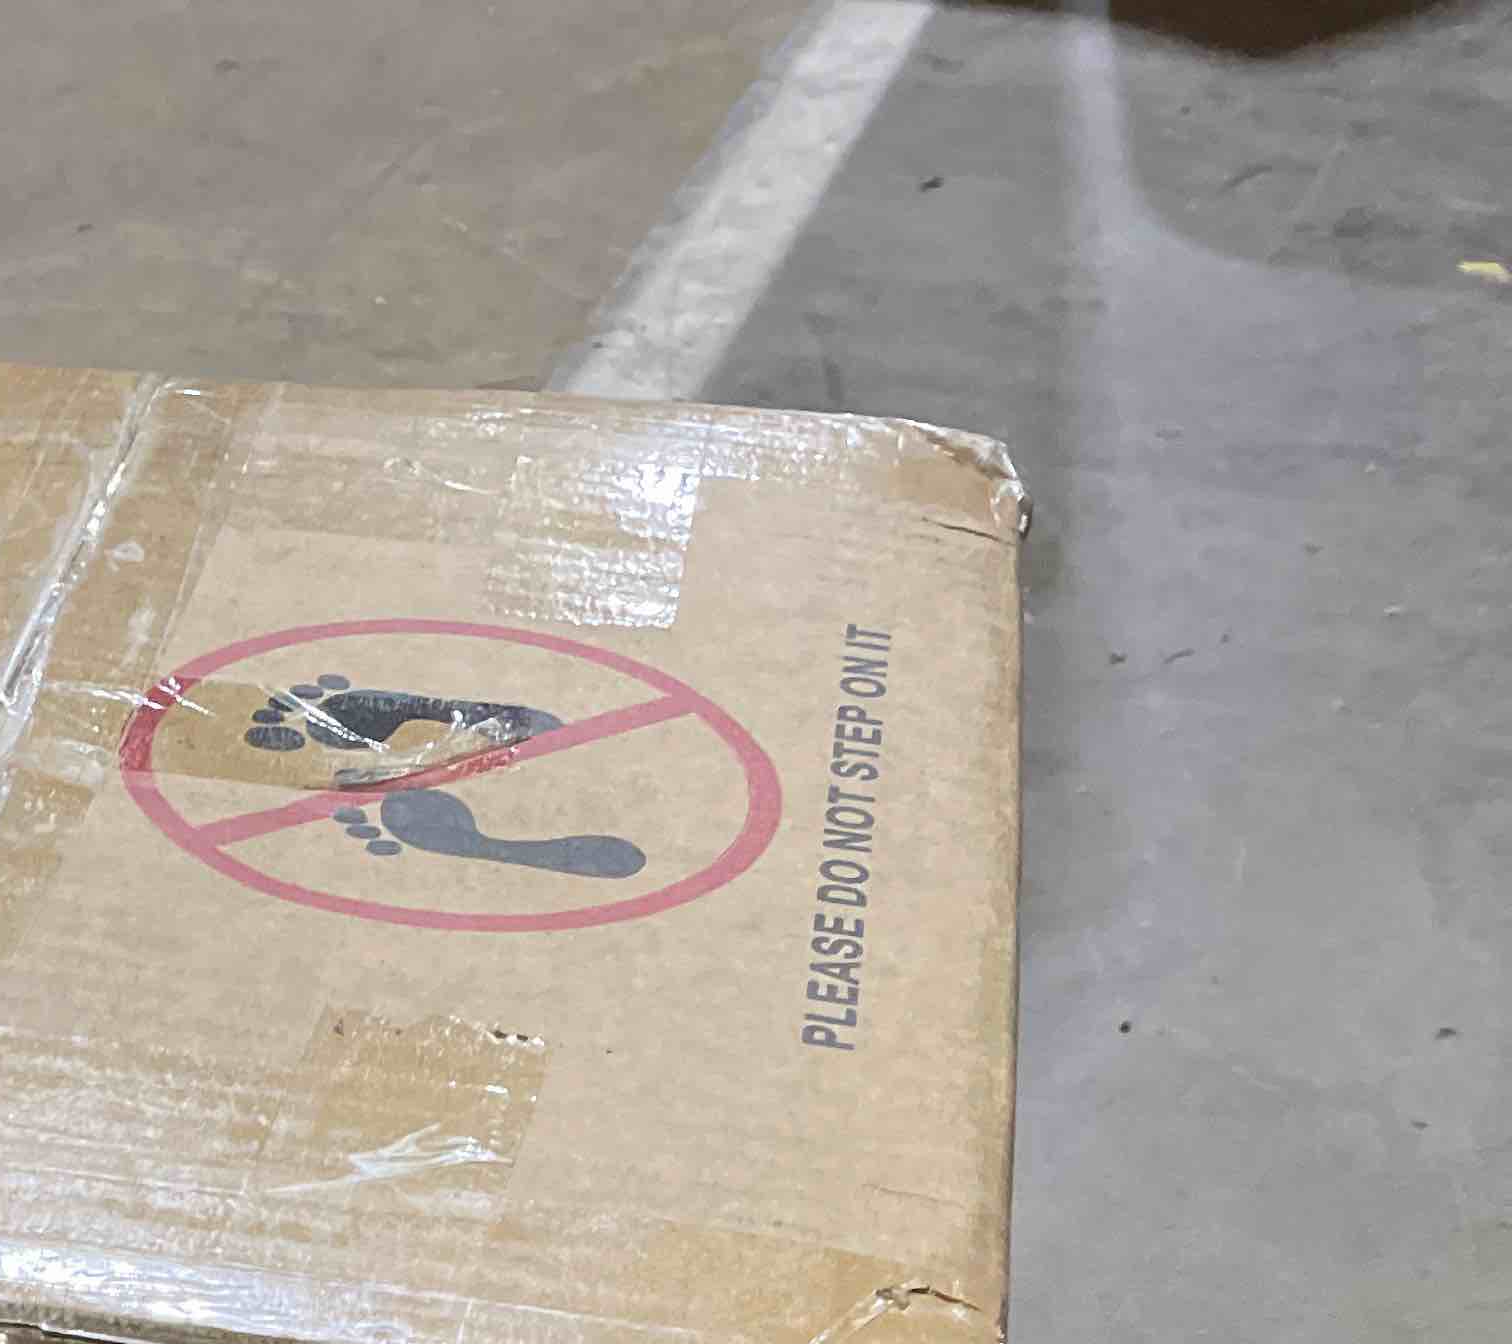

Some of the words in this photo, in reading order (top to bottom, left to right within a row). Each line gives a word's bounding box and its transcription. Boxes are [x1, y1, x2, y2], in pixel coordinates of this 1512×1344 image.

[845, 623, 892, 652] IT
[839, 655, 888, 699] ON
[830, 704, 884, 782] STEP
[822, 784, 876, 853] NOT
[816, 859, 870, 908] DO
[801, 913, 865, 1050] PLEASE
